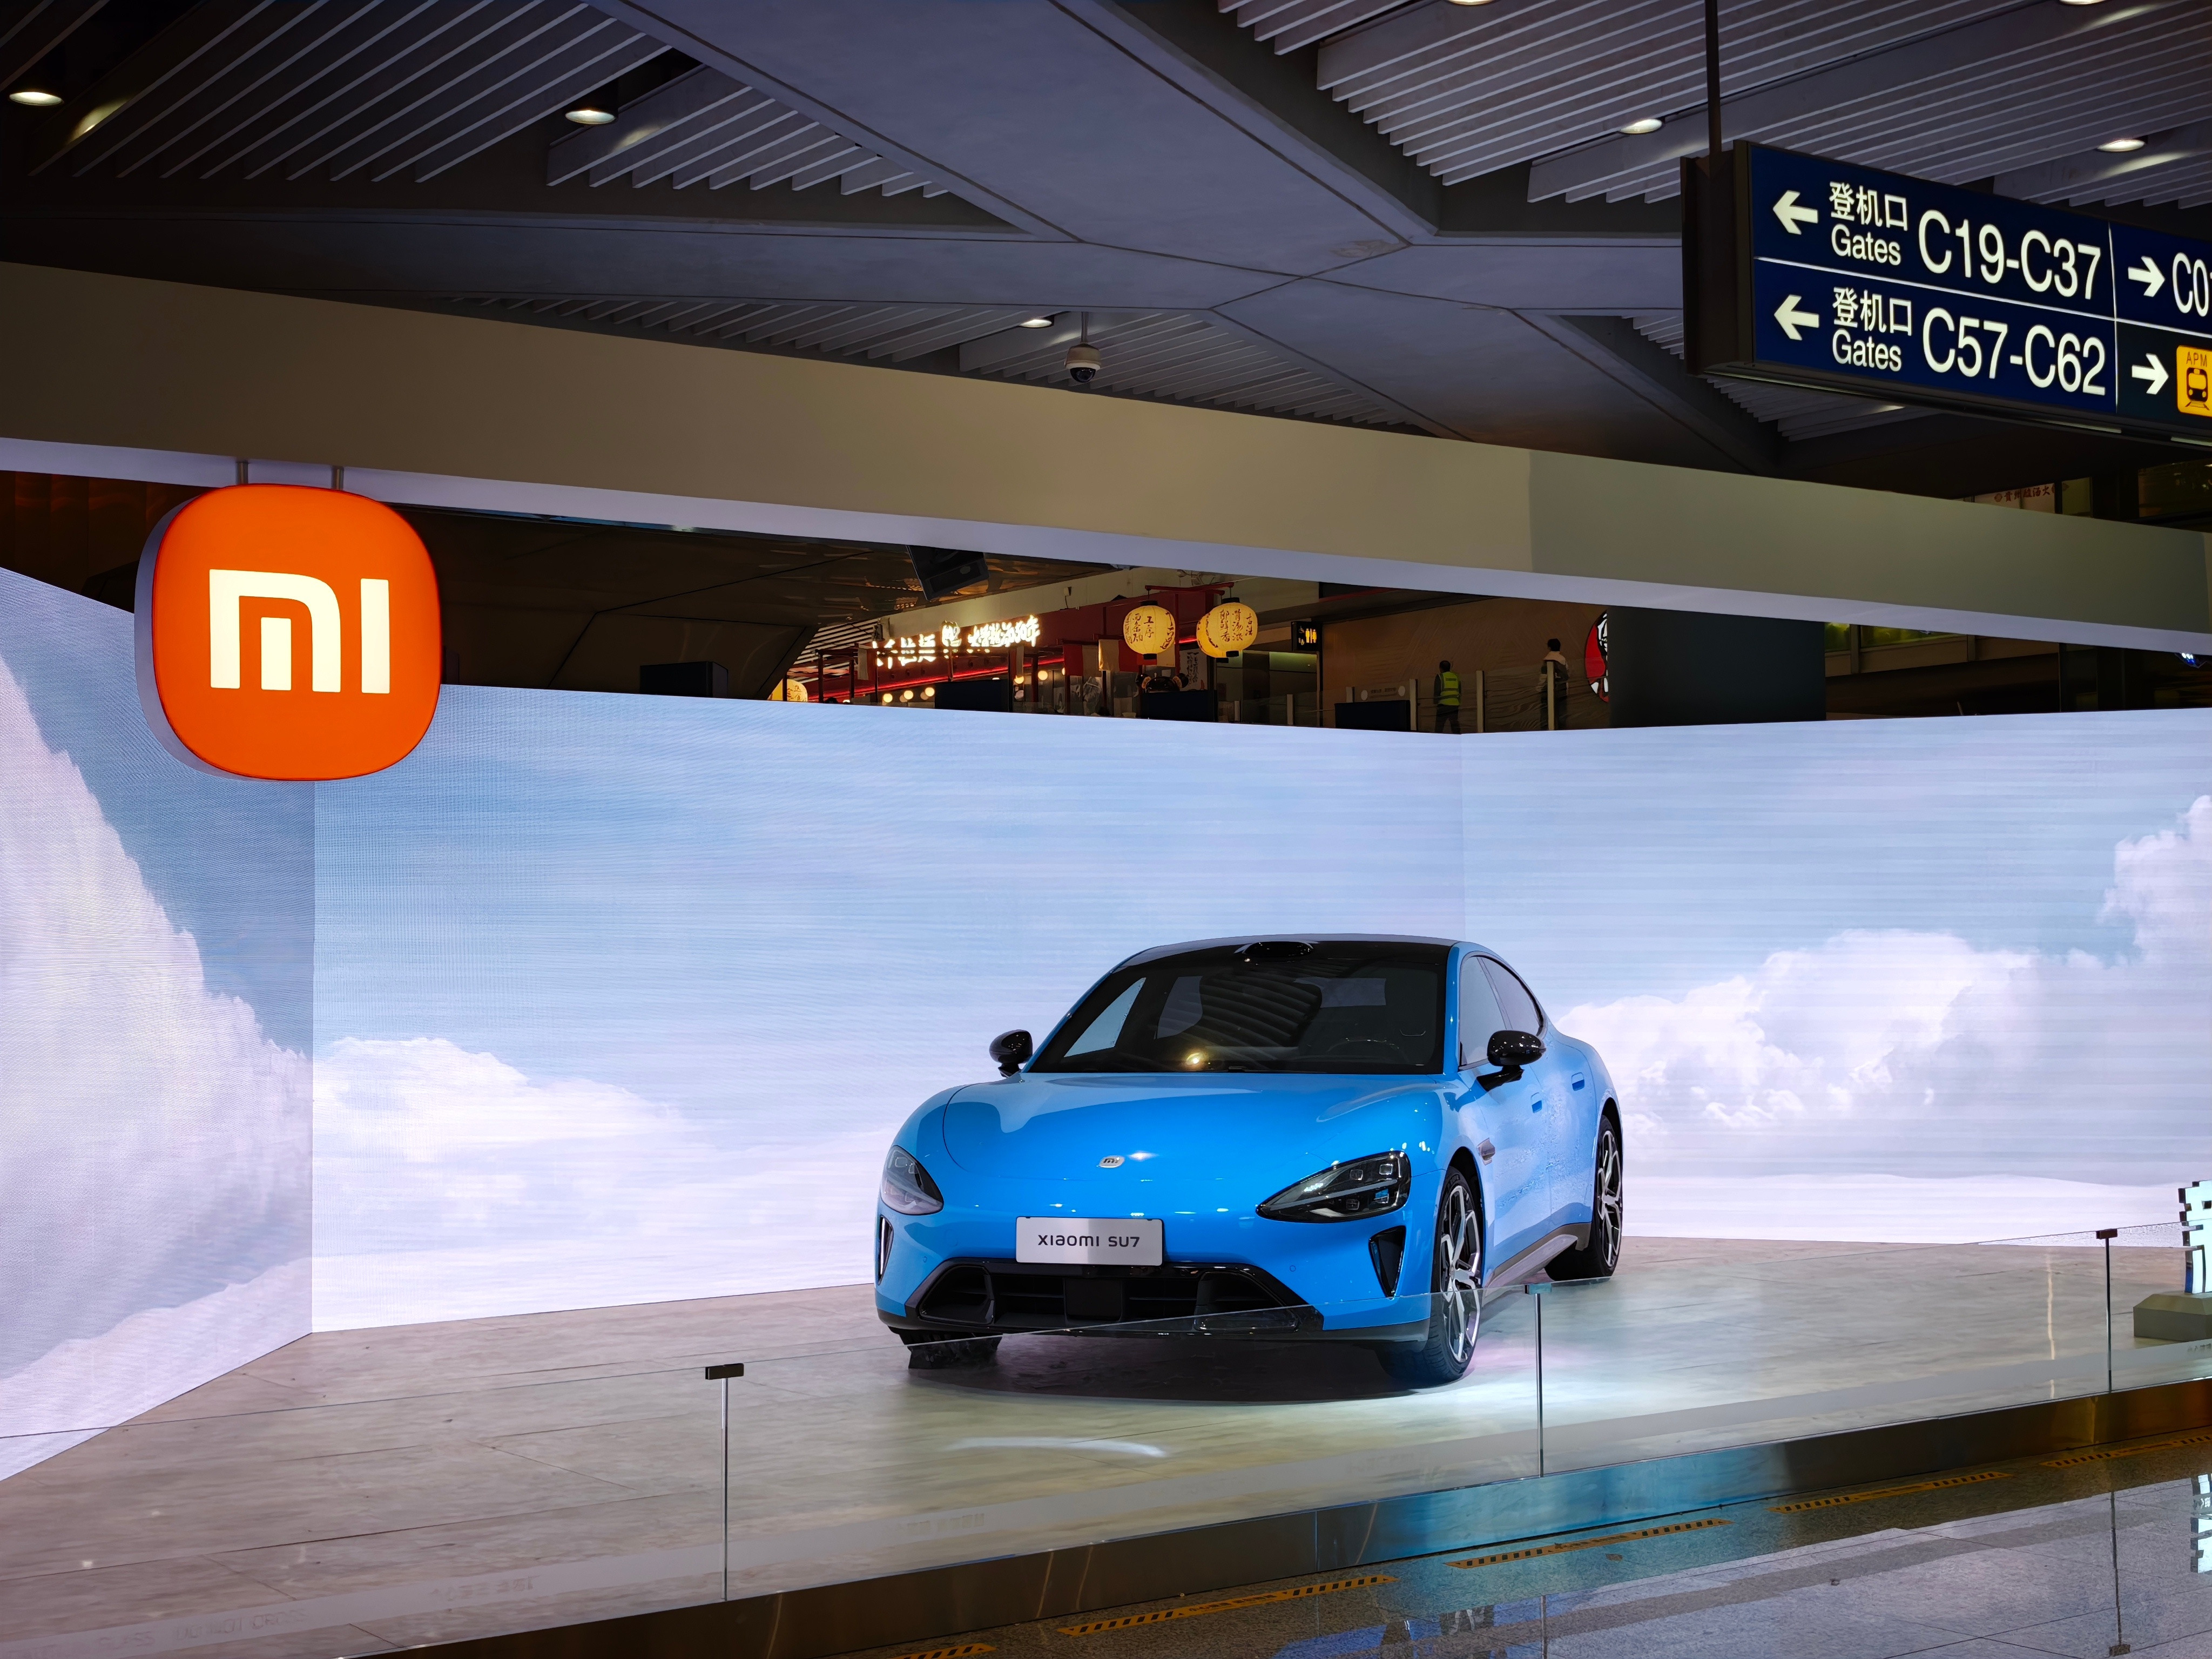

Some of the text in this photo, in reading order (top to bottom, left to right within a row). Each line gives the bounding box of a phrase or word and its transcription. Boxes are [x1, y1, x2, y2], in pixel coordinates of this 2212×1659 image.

[1829, 182, 1908, 231] 登机口
[1831, 224, 1901, 266] Gates
[1918, 210, 2101, 300] C19-C37
[2172, 253, 2212, 317] C0
[1832, 287, 1912, 336] 登机口
[1832, 329, 1901, 372] Gates
[1923, 307, 2105, 395] C57-C62
[2186, 351, 2207, 368] APM
[1108, 1236, 1140, 1247] SU7
